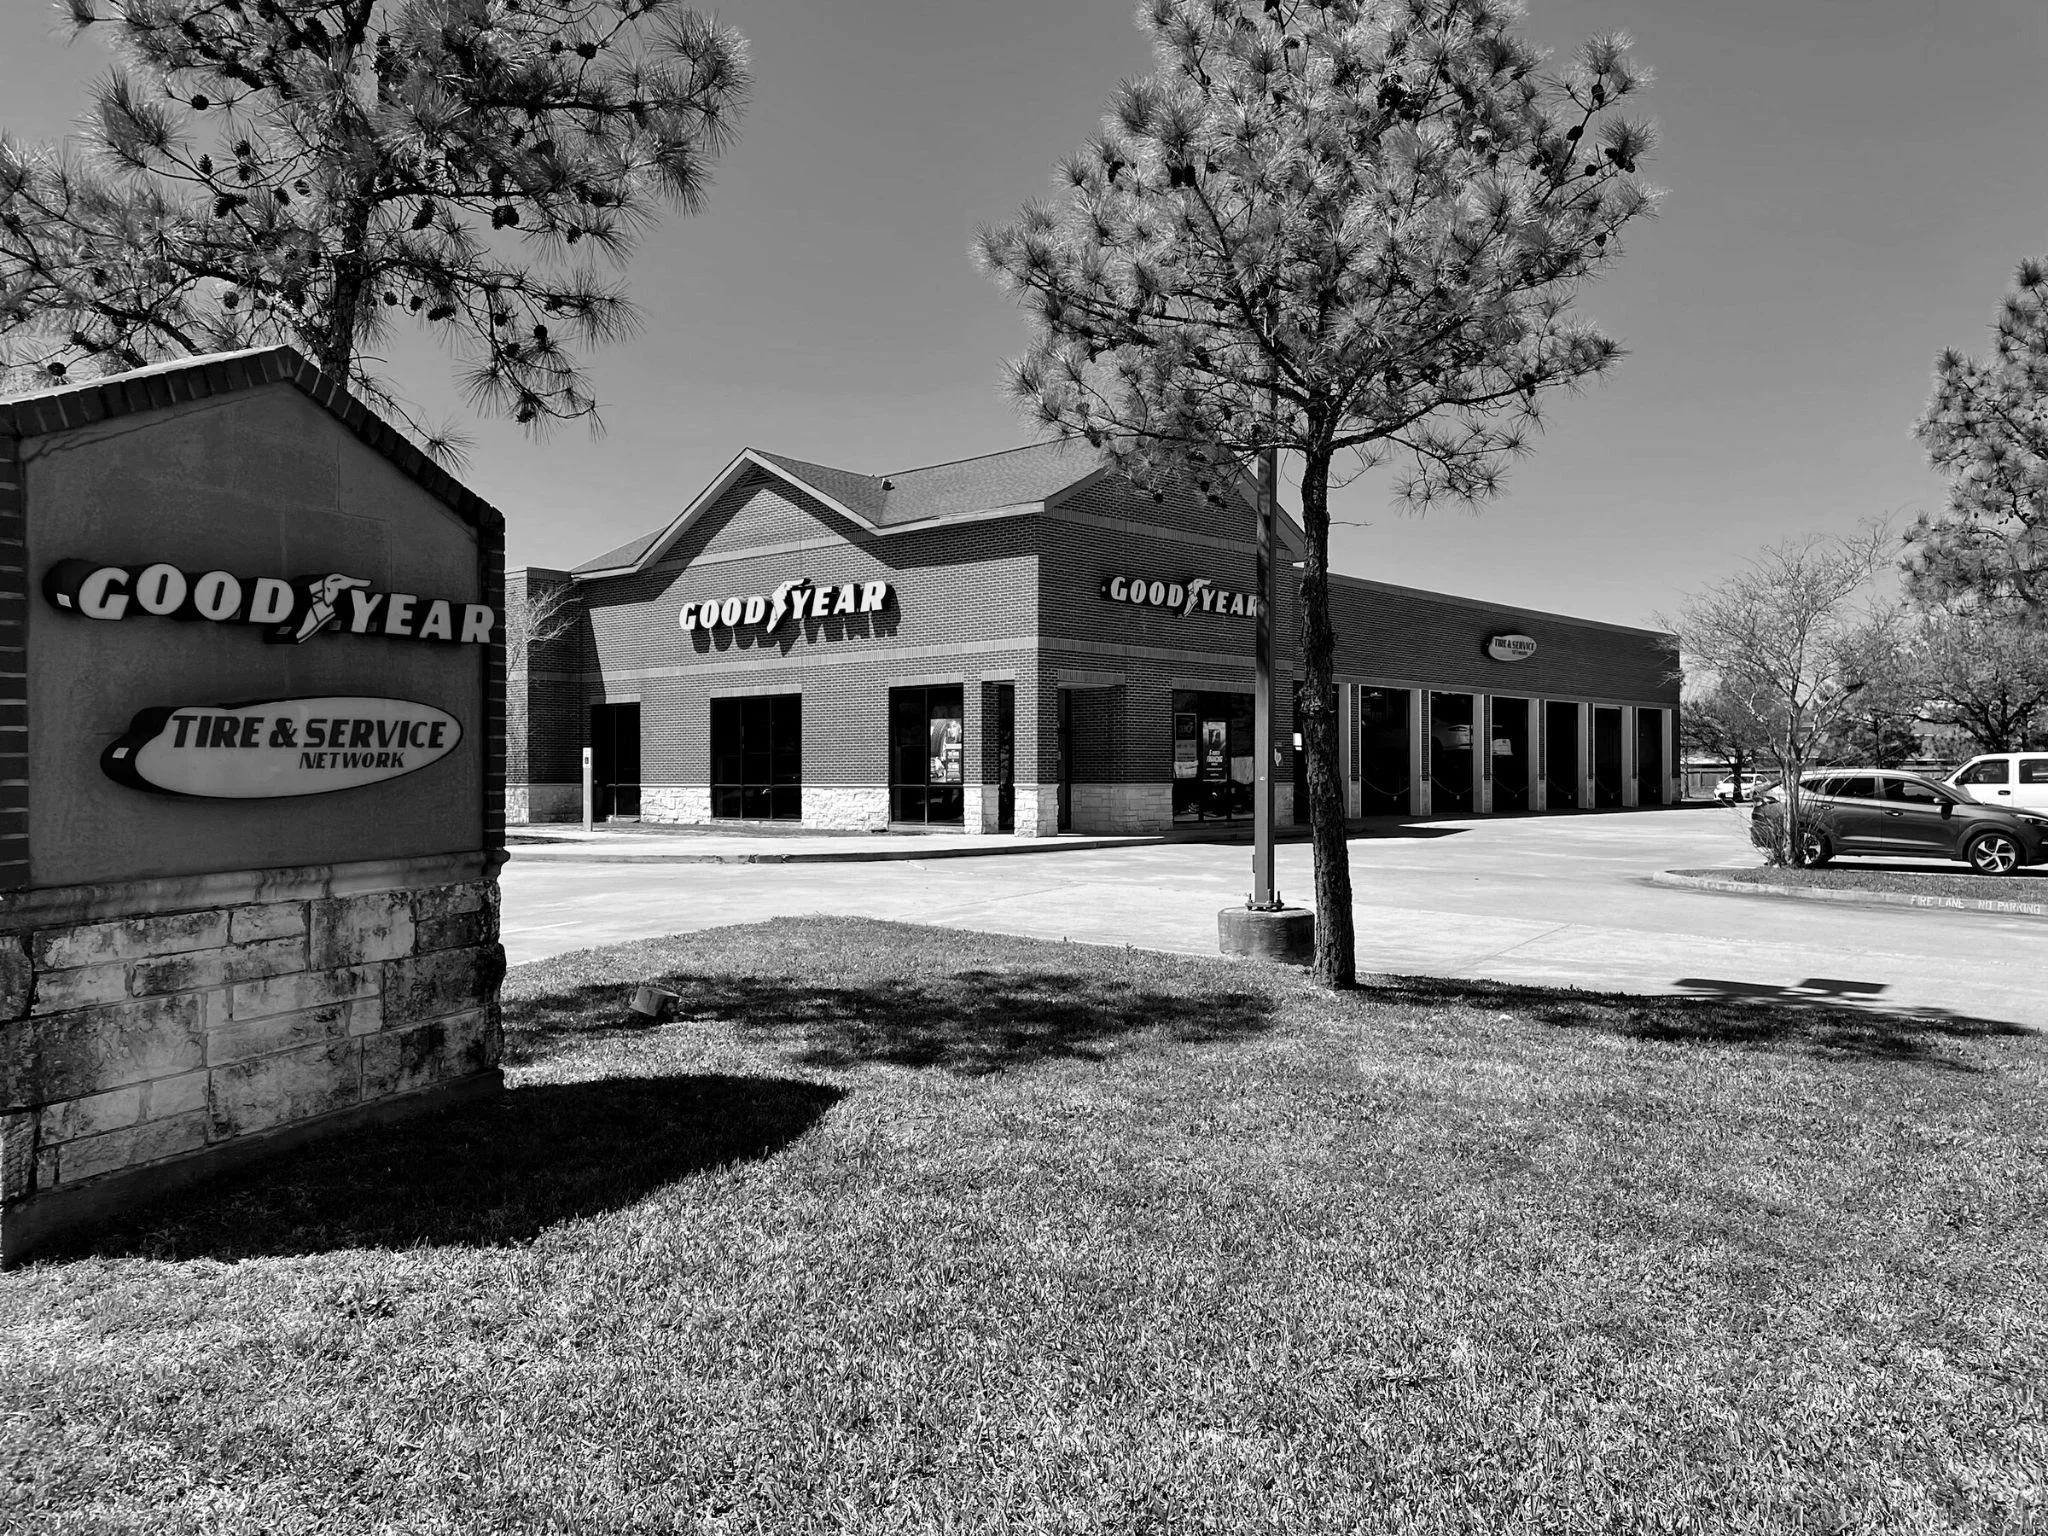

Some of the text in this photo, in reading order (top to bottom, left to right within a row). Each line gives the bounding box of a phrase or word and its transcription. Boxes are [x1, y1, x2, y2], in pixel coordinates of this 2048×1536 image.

[172, 715, 264, 748] TIRE
[303, 718, 447, 749] SERVICE
[299, 752, 405, 769] NETWORK
[1910, 895, 2041, 914] FIRE LANE NO PARKING
